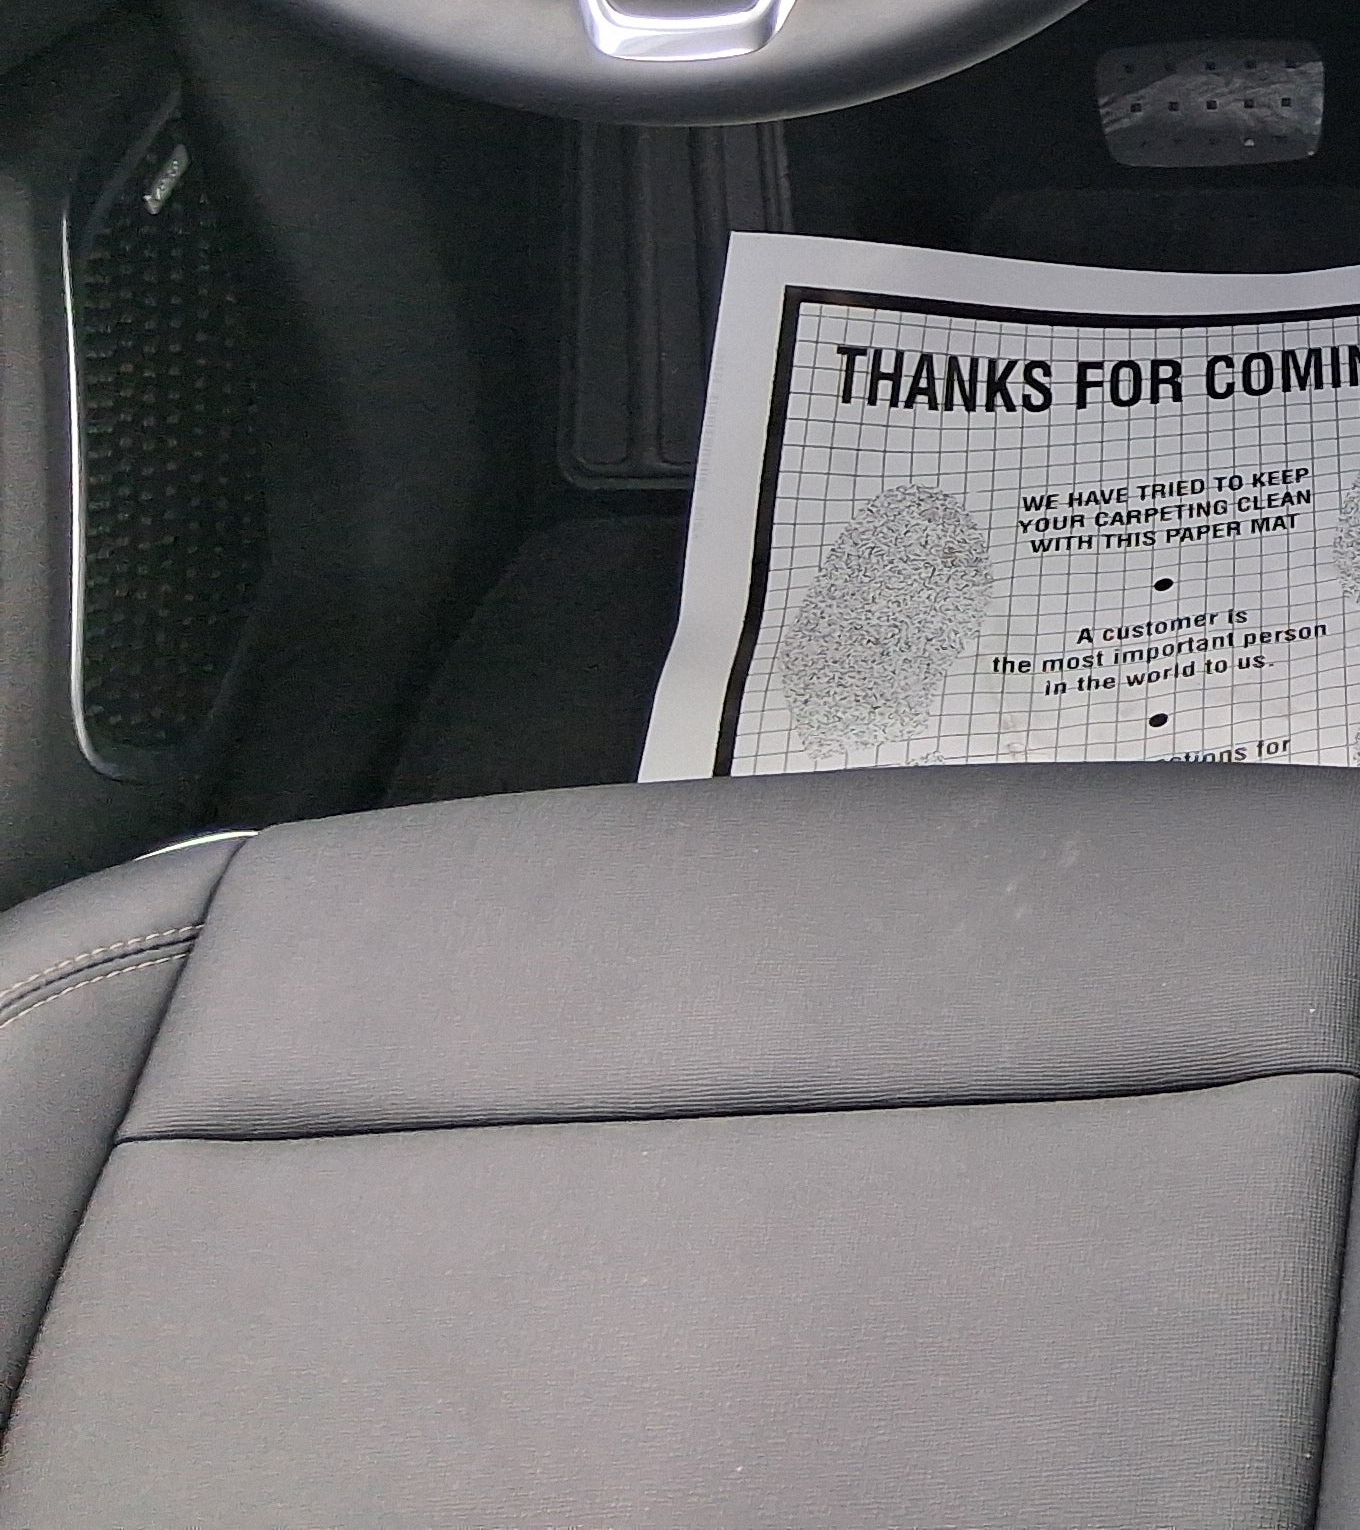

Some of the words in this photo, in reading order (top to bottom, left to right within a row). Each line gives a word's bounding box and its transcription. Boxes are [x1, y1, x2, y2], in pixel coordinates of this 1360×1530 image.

[836, 346, 1052, 413] THANKS
[1076, 359, 1183, 410] FOR
[1018, 516, 1085, 534] YOUR
[1094, 499, 1229, 527] CARPETING
[1237, 488, 1312, 513] CLEAN
[1022, 494, 1061, 512] WE
[1068, 488, 1129, 508] HAVE
[1136, 478, 1206, 501] TRIED
[1213, 474, 1244, 492] TO
[1251, 467, 1310, 488] KEEP
[1030, 535, 1092, 553] WITH
[1104, 530, 1157, 549] THIS
[1165, 520, 1242, 544] PAPER
[1251, 513, 1299, 534] MAT
[1076, 628, 1094, 644] A
[1102, 611, 1219, 642] customer
[1227, 608, 1248, 625] is
[992, 657, 1032, 674] the
[1041, 650, 1104, 673] most
[1113, 632, 1234, 663] important
[1243, 623, 1327, 648] person
[1045, 680, 1067, 696] in
[1076, 674, 1116, 692] the
[1126, 661, 1196, 689] world
[1205, 658, 1228, 675] to
[1237, 652, 1275, 670] us.
[1157, 746, 1248, 763] tions
[1256, 738, 1292, 758] for
